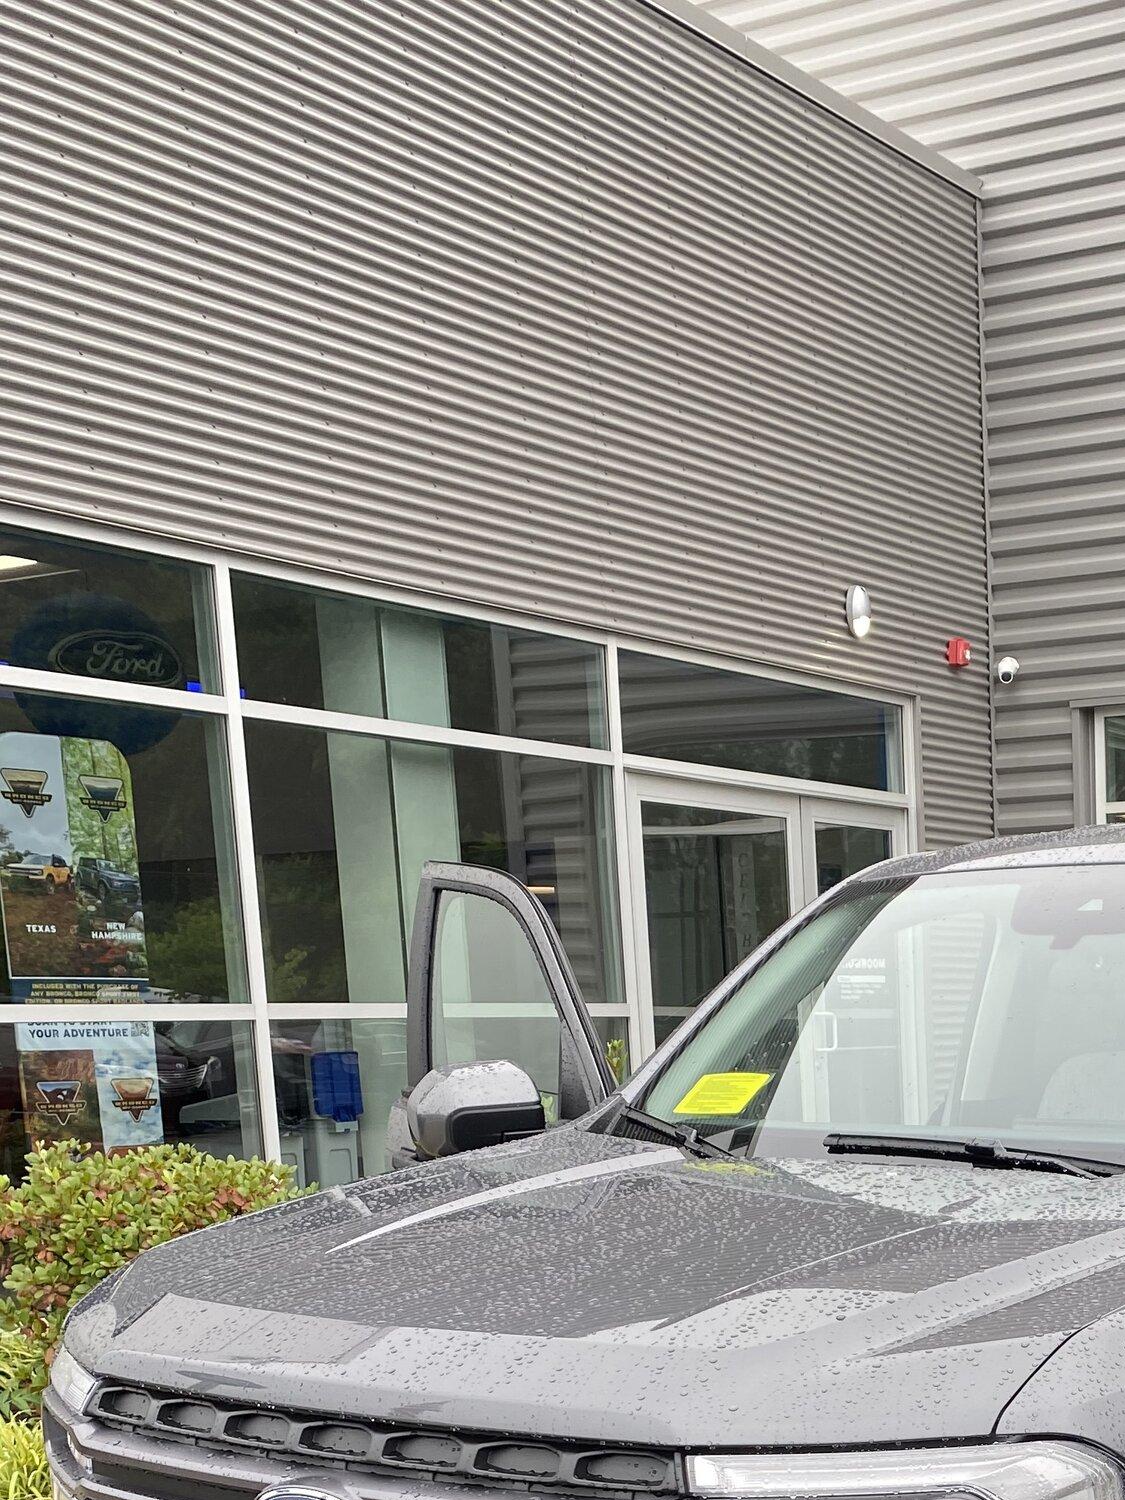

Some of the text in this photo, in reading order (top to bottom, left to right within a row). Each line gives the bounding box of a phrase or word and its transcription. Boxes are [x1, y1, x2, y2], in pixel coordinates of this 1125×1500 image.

[86, 640, 165, 677] Ford
[4, 792, 50, 801] BRONCO
[82, 798, 125, 807] BRONCO
[25, 924, 57, 933] TEXAS
[106, 922, 126, 930] NEW
[91, 931, 144, 940] HAMPSHIRE
[29, 1028, 129, 1039] YOUR ADVENTURE
